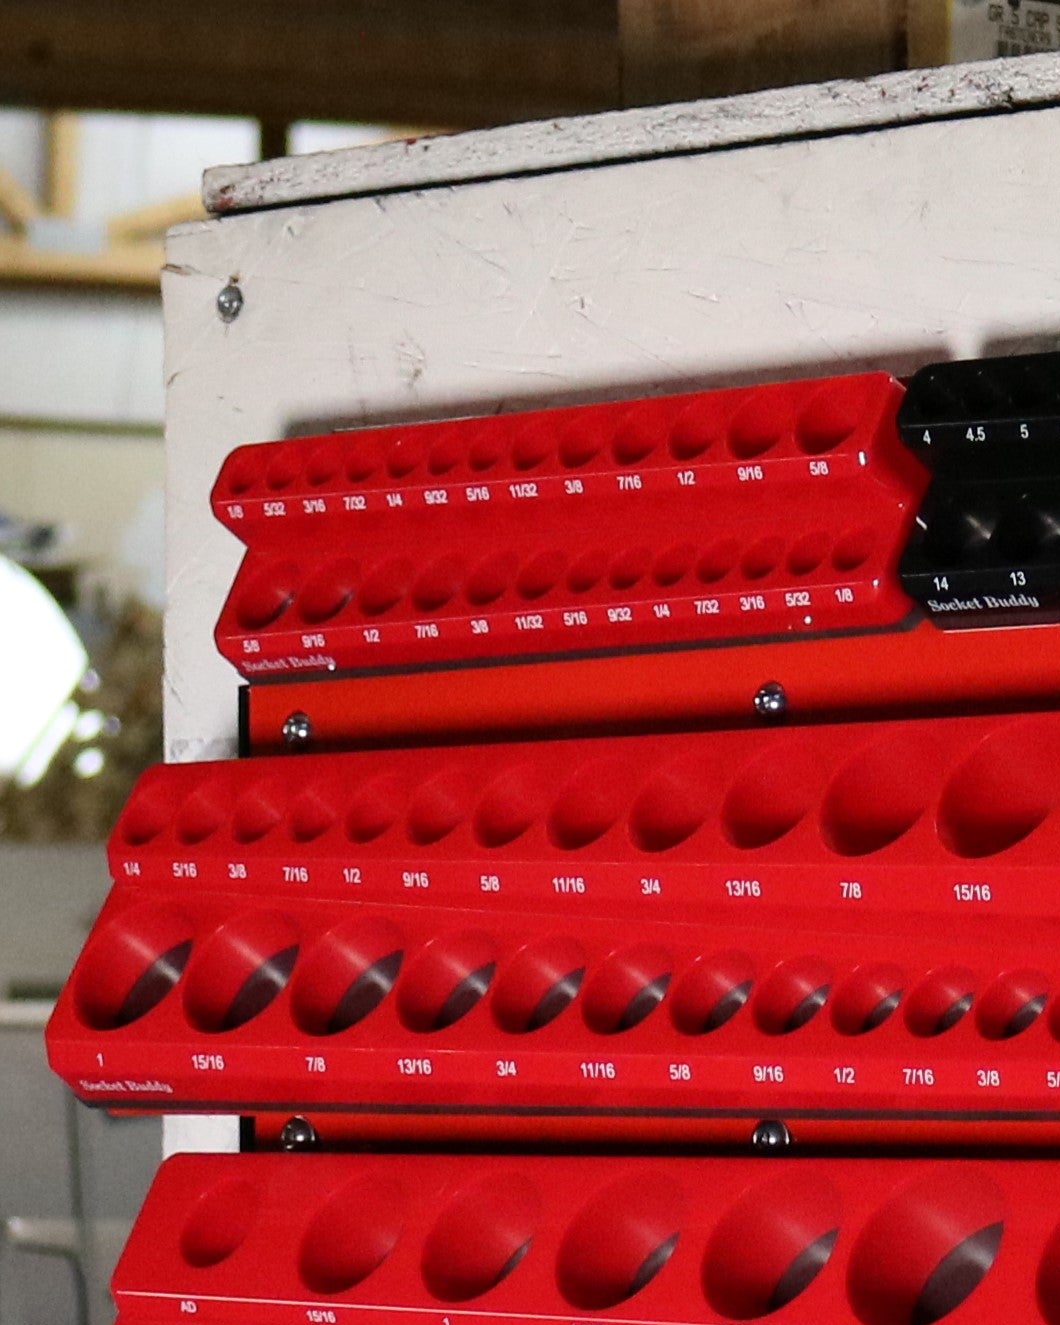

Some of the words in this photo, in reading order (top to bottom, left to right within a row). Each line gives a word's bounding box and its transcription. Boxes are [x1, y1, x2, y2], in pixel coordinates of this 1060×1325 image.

[922, 429, 932, 445] 4
[965, 426, 986, 442] 4.5
[1020, 423, 1029, 439] 5
[302, 498, 327, 514] 3/16
[342, 495, 367, 511] 7/32
[386, 493, 403, 507] 1/4
[423, 489, 449, 505] 9/32
[465, 486, 490, 502] 5/16
[509, 482, 539, 498] 11/32
[564, 479, 584, 495] 3/8
[616, 474, 642, 490] 7/16
[676, 470, 696, 486] 1/2
[737, 465, 763, 482] 9/16
[809, 460, 829, 476] 5/8
[933, 576, 949, 591] 14
[1009, 571, 1027, 586] 13
[363, 628, 381, 643] 1/2
[414, 623, 439, 639] 7/16
[470, 619, 489, 634] 3/8
[514, 614, 544, 630] 11/32
[563, 610, 588, 626] 5/16
[607, 607, 633, 623] 9/32
[653, 603, 671, 618] 1/4
[693, 599, 720, 615] 7/32
[739, 595, 765, 611] 3/16
[785, 591, 811, 607] 5/32
[834, 587, 854, 603] 1/8
[927, 597, 983, 612] Socket
[987, 593, 1040, 609] Buddy
[123, 861, 141, 876] 1/4
[172, 862, 198, 878] 5/16
[227, 863, 247, 879] 3/8
[282, 866, 309, 883] 7/16
[343, 867, 362, 884] 1/2
[402, 871, 429, 888] 9/16
[480, 875, 500, 892] 5/8
[552, 877, 586, 894] 11/16
[640, 878, 661, 895] 3/4
[725, 880, 761, 897] 13/16
[839, 882, 862, 899] 7/8
[953, 884, 991, 902] 15/16
[96, 1052, 104, 1067] 1
[191, 1054, 225, 1071] 15/16
[305, 1056, 326, 1073] 7/8
[397, 1058, 432, 1075] 13/16
[496, 1060, 517, 1077] 3/4
[580, 1062, 616, 1079] 11/16
[669, 1064, 691, 1081] 5/8
[753, 1065, 784, 1083] 9/16
[833, 1067, 855, 1084] 1/2
[902, 1068, 935, 1086] 7/16
[976, 1069, 1000, 1087] 3/8
[306, 1310, 337, 1324] 15/16
